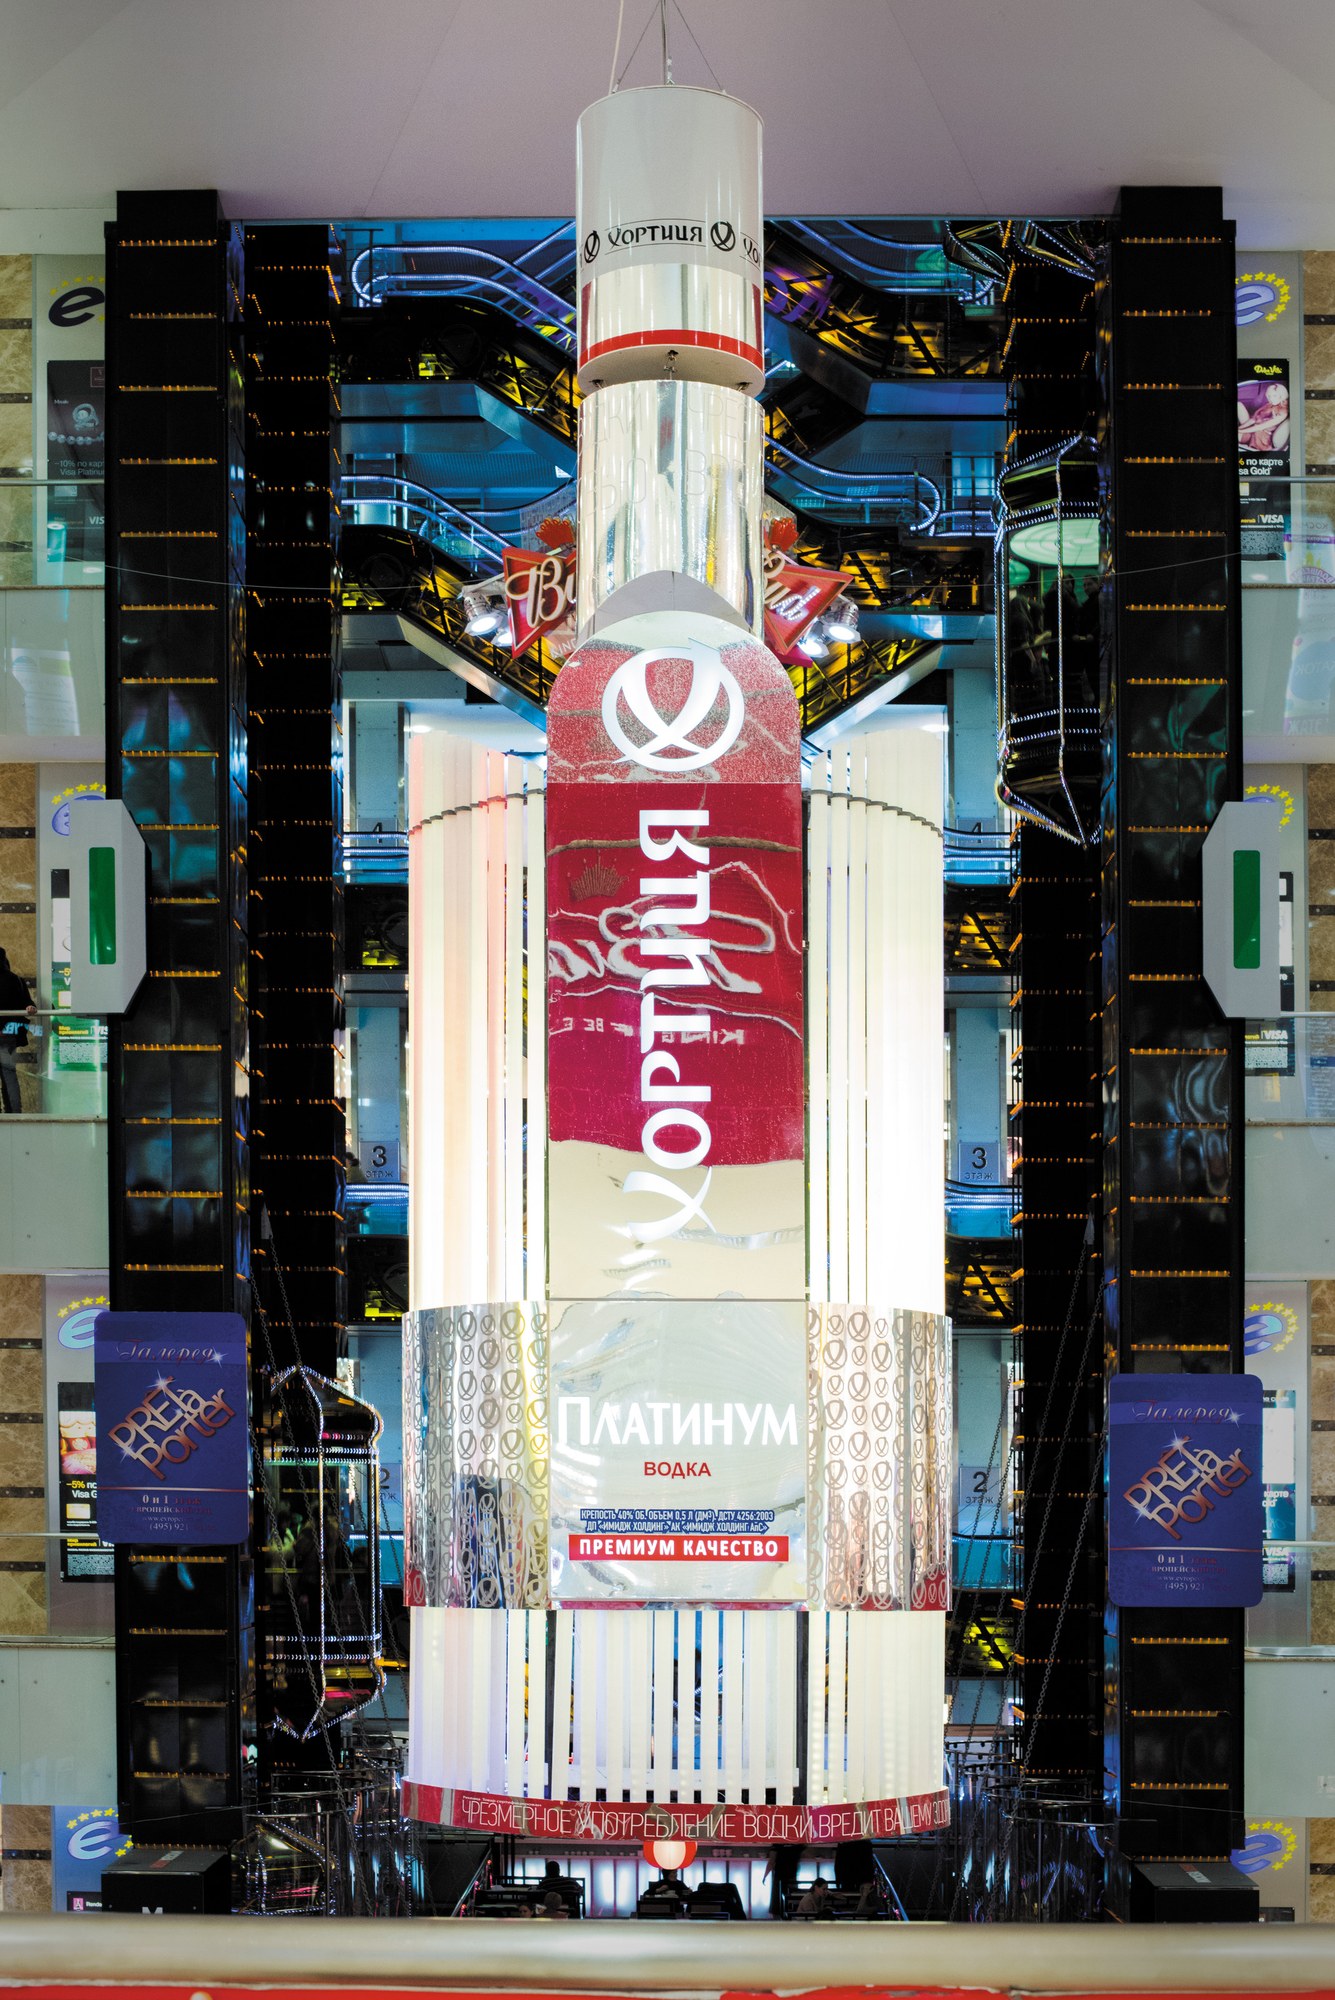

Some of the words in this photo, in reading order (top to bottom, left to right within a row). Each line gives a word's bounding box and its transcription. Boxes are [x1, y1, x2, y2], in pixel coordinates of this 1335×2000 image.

[1259, 459, 1284, 468] карте
[1260, 514, 1285, 524] VISA
[372, 1145, 387, 1168] 3
[972, 1146, 987, 1169] 3
[964, 1171, 993, 1180] этаж
[643, 1461, 712, 1479] ВОДКА
[972, 1471, 988, 1493] 2
[71, 1490, 89, 1498] Visa
[581, 1510, 617, 1520] КРЕПОСТЬ
[618, 1510, 634, 1520] 40%
[648, 1510, 673, 1520] ОБЪЕМ
[718, 1511, 736, 1521] ДСТУ
[737, 1511, 774, 1521] 4256:2003
[586, 1521, 597, 1531] ДП
[671, 1522, 681, 1531] АК
[716, 1522, 749, 1532] ХОЛДИНГ
[580, 1539, 675, 1555] ПРЕМИУМ
[683, 1540, 779, 1556] КАЧЕСТВО
[462, 1799, 572, 1834] ЧРЕЗМЕРНОЕ
[577, 1810, 736, 1839] УПОТРЕБЛЕНИЕ
[743, 1814, 813, 1840] ВОДКИ
[818, 1809, 882, 1838] ВРЕДИТ
[884, 1802, 932, 1832] ВАШЕМУ
